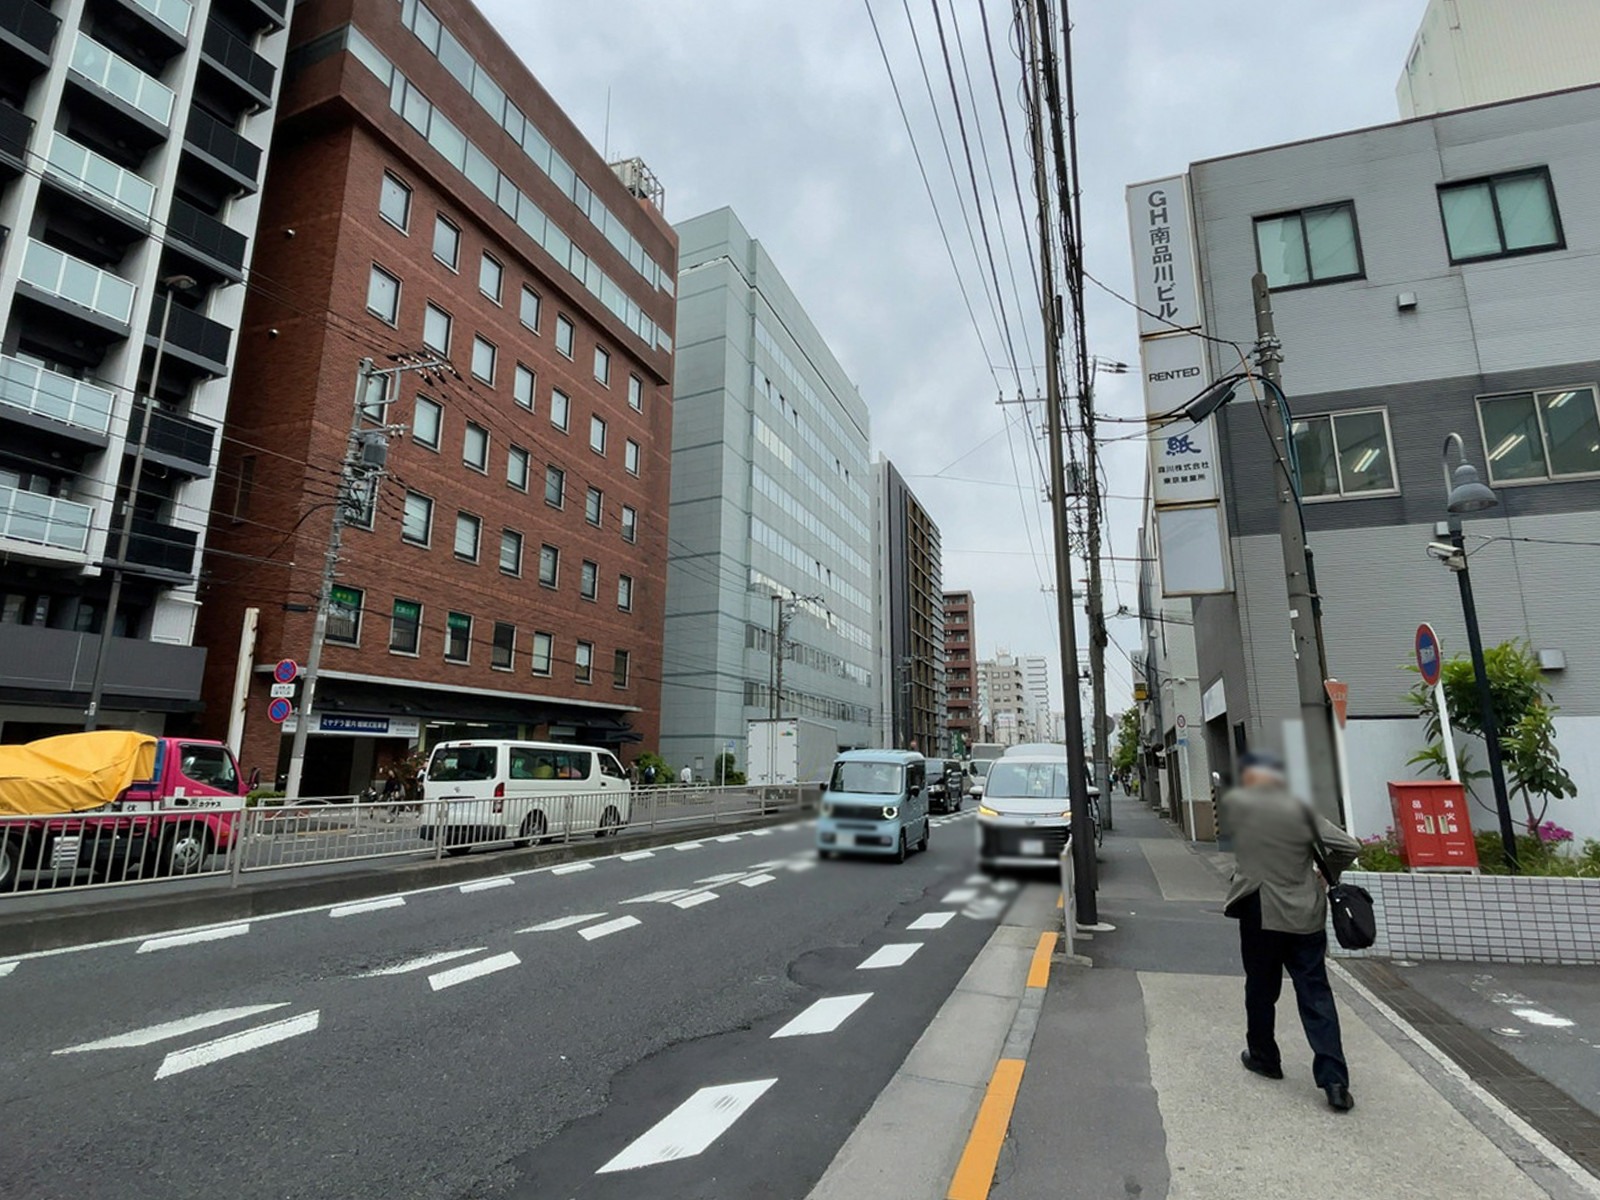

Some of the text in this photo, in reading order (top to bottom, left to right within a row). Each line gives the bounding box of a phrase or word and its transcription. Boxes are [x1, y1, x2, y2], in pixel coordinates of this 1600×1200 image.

[1147, 190, 1178, 318] GH南品川ビル
[1148, 366, 1201, 382] RENTED
